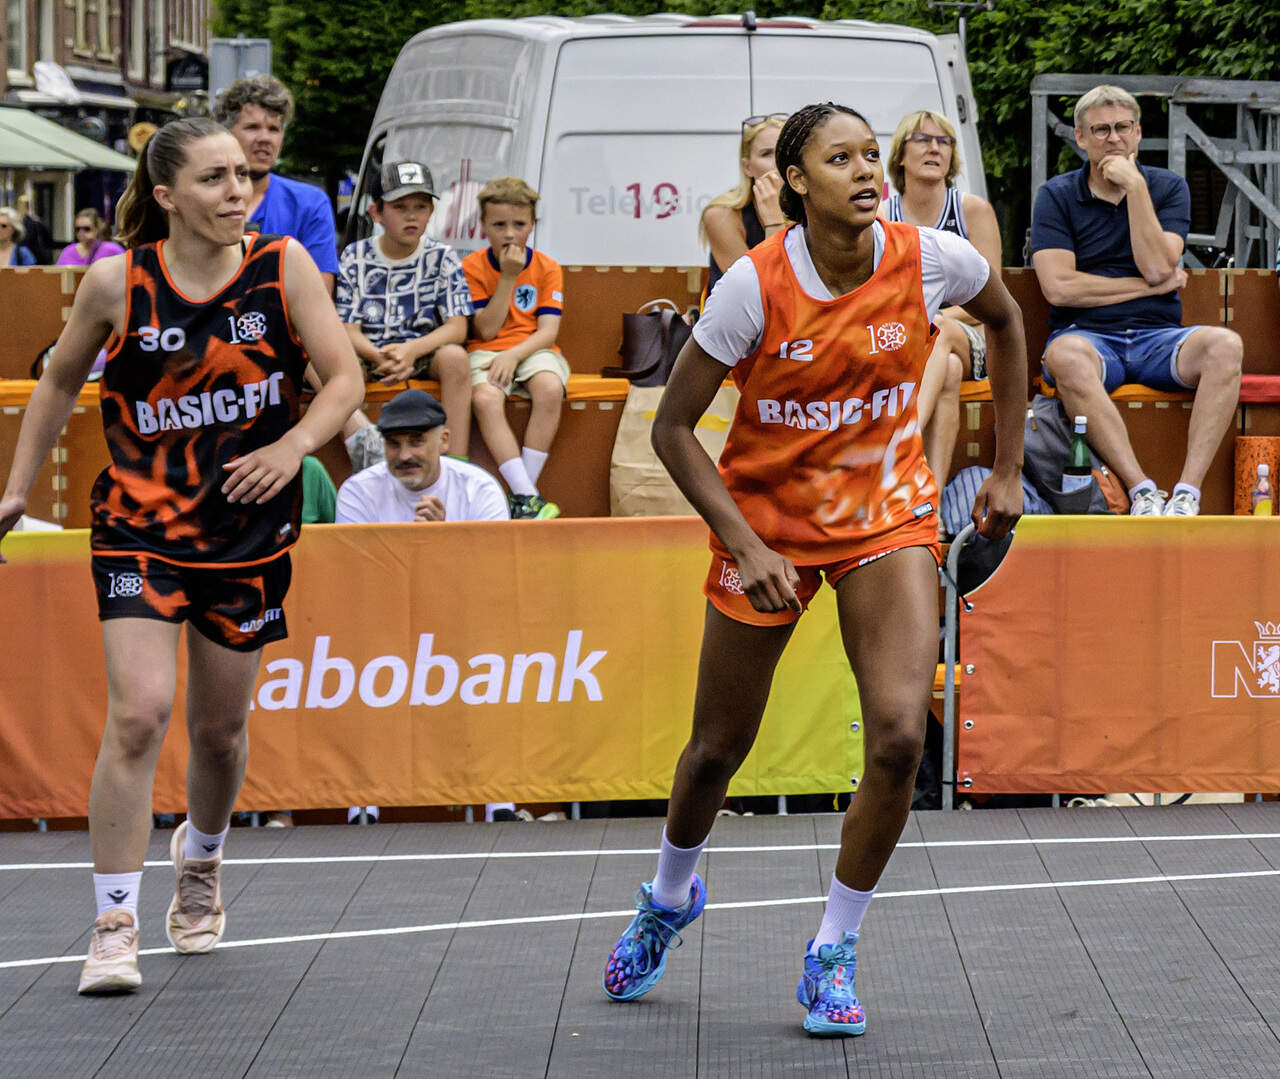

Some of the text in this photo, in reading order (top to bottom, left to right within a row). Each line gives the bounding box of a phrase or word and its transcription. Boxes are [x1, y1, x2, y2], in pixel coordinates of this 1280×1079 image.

[626, 182, 679, 219] 19
[138, 325, 186, 352] 30
[779, 339, 814, 362] 12
[135, 371, 285, 435] BASIC-FIT
[757, 381, 917, 432] BASIC-FIT
[249, 629, 608, 711] abobank
